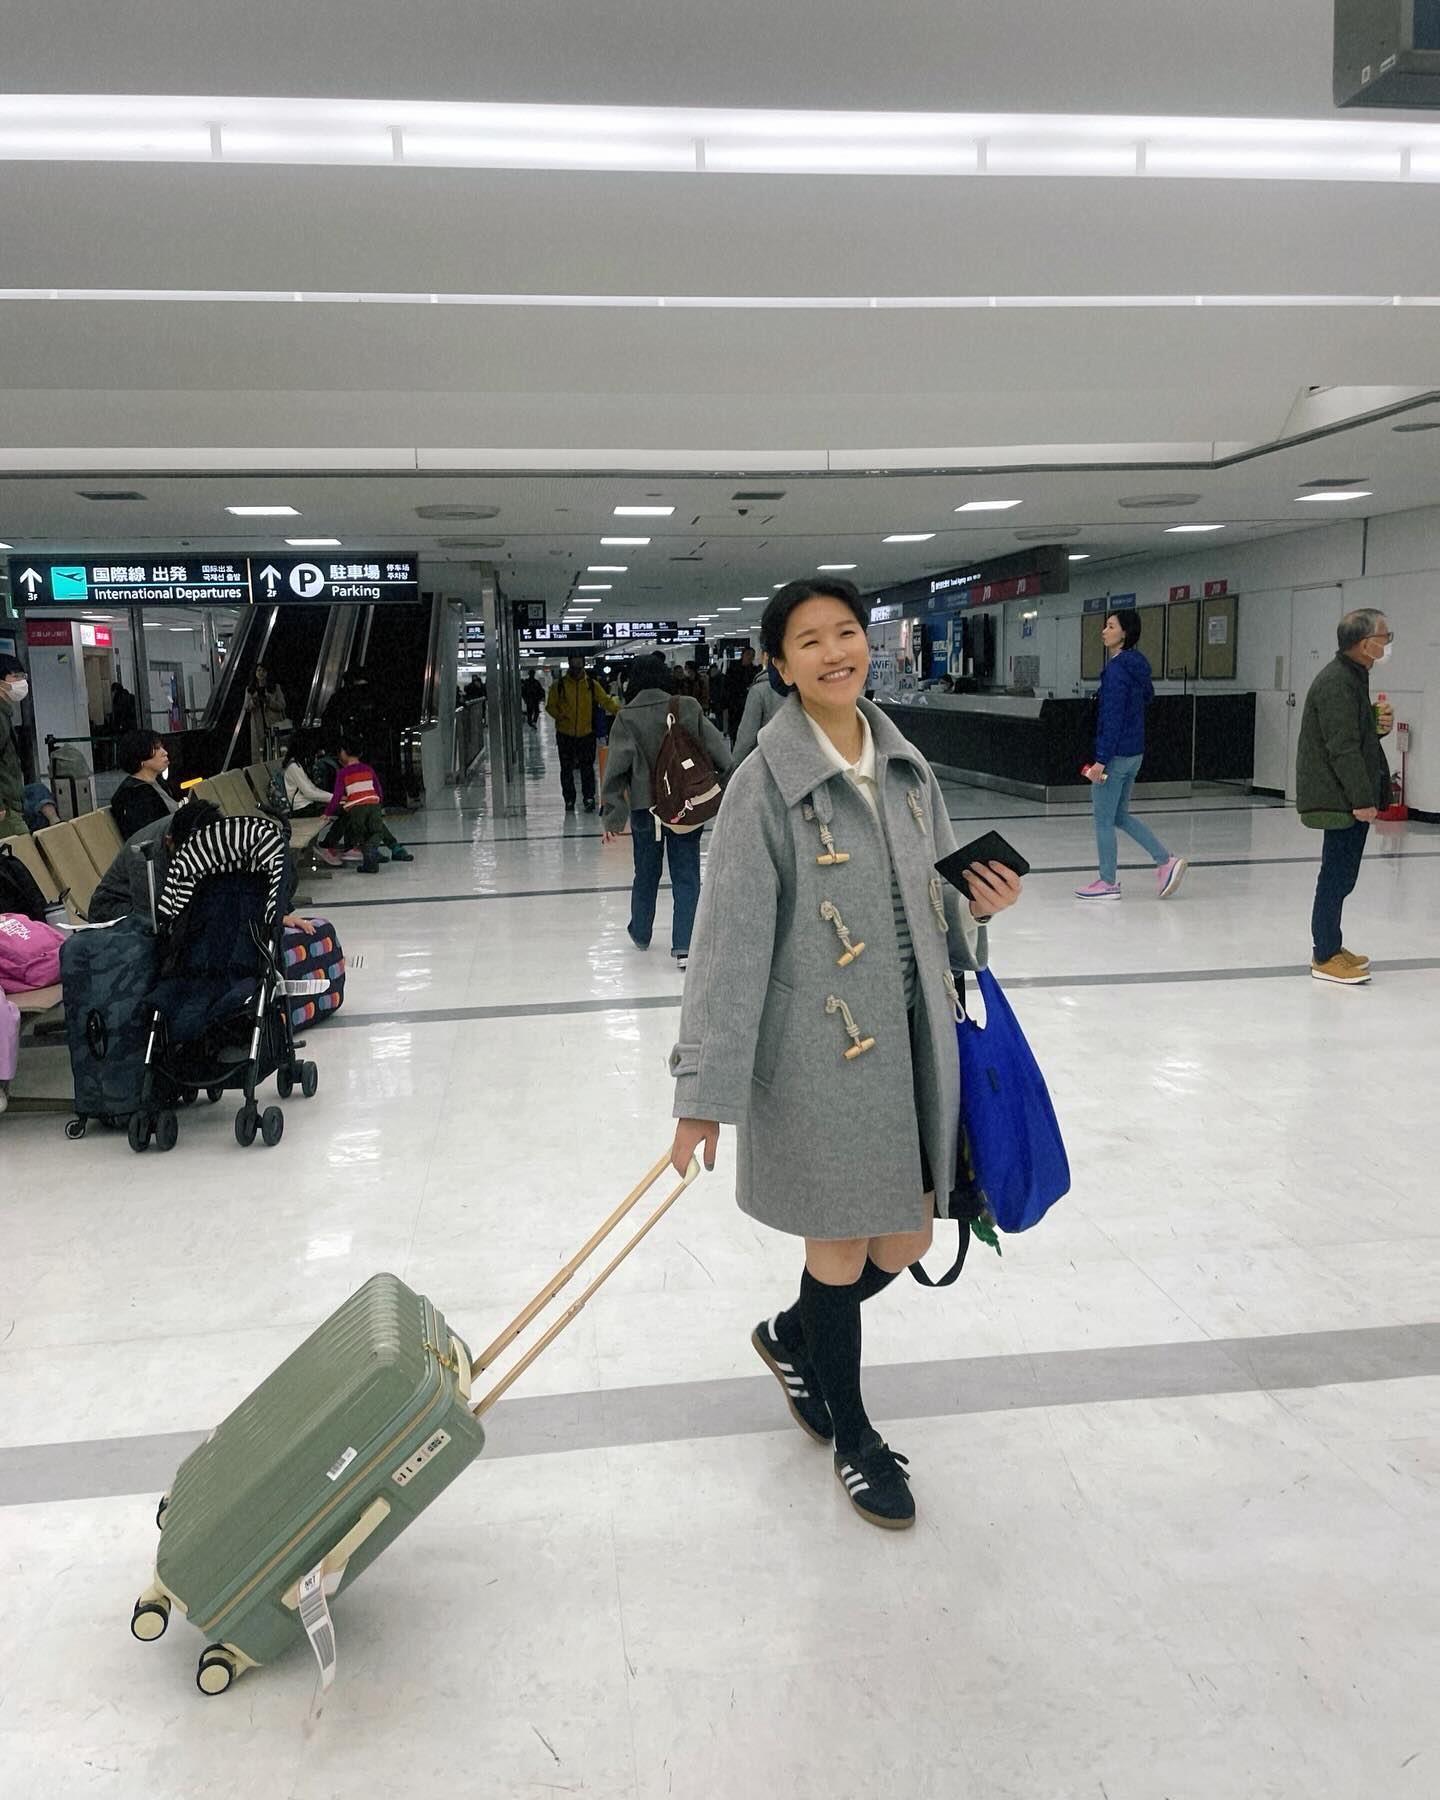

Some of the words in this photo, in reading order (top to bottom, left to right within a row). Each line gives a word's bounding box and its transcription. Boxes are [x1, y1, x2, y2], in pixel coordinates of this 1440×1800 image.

[92, 566, 146, 582] 国際線
[152, 566, 187, 581] 出発
[329, 564, 380, 579] 駐車場
[27, 592, 38, 601] 3F
[94, 587, 173, 600] International
[179, 587, 241, 601] Departures
[266, 589, 277, 598] 2F
[331, 585, 380, 598] Parking
